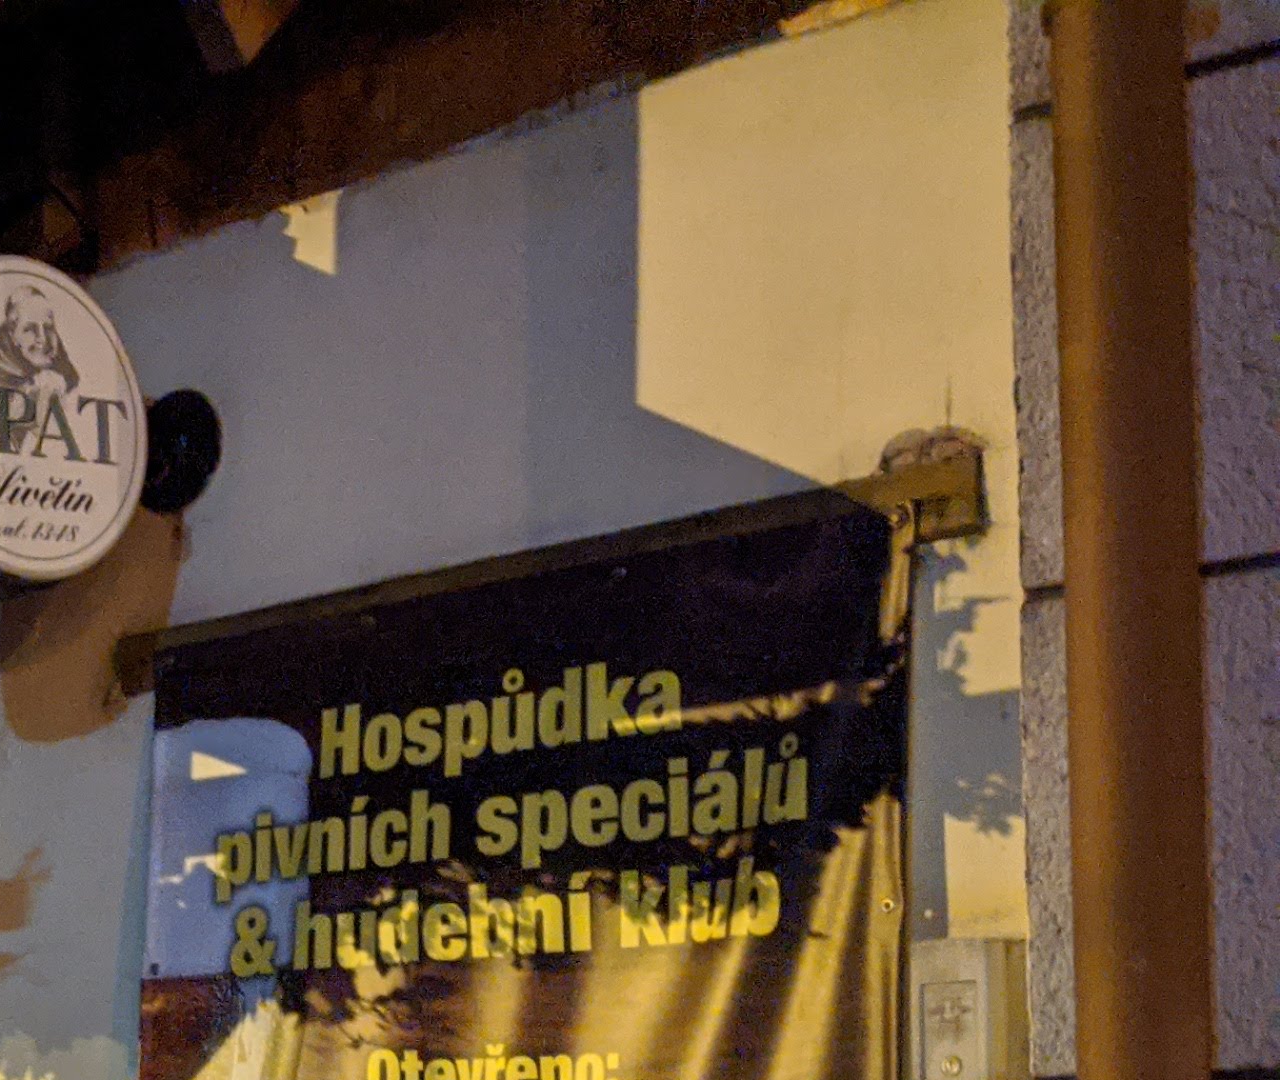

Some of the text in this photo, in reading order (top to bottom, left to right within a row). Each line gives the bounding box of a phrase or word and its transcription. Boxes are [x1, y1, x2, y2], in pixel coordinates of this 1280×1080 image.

[320, 662, 682, 778] Hospůdka
[217, 732, 808, 902] pivních speciálů
[230, 857, 780, 978] & hudební klub
